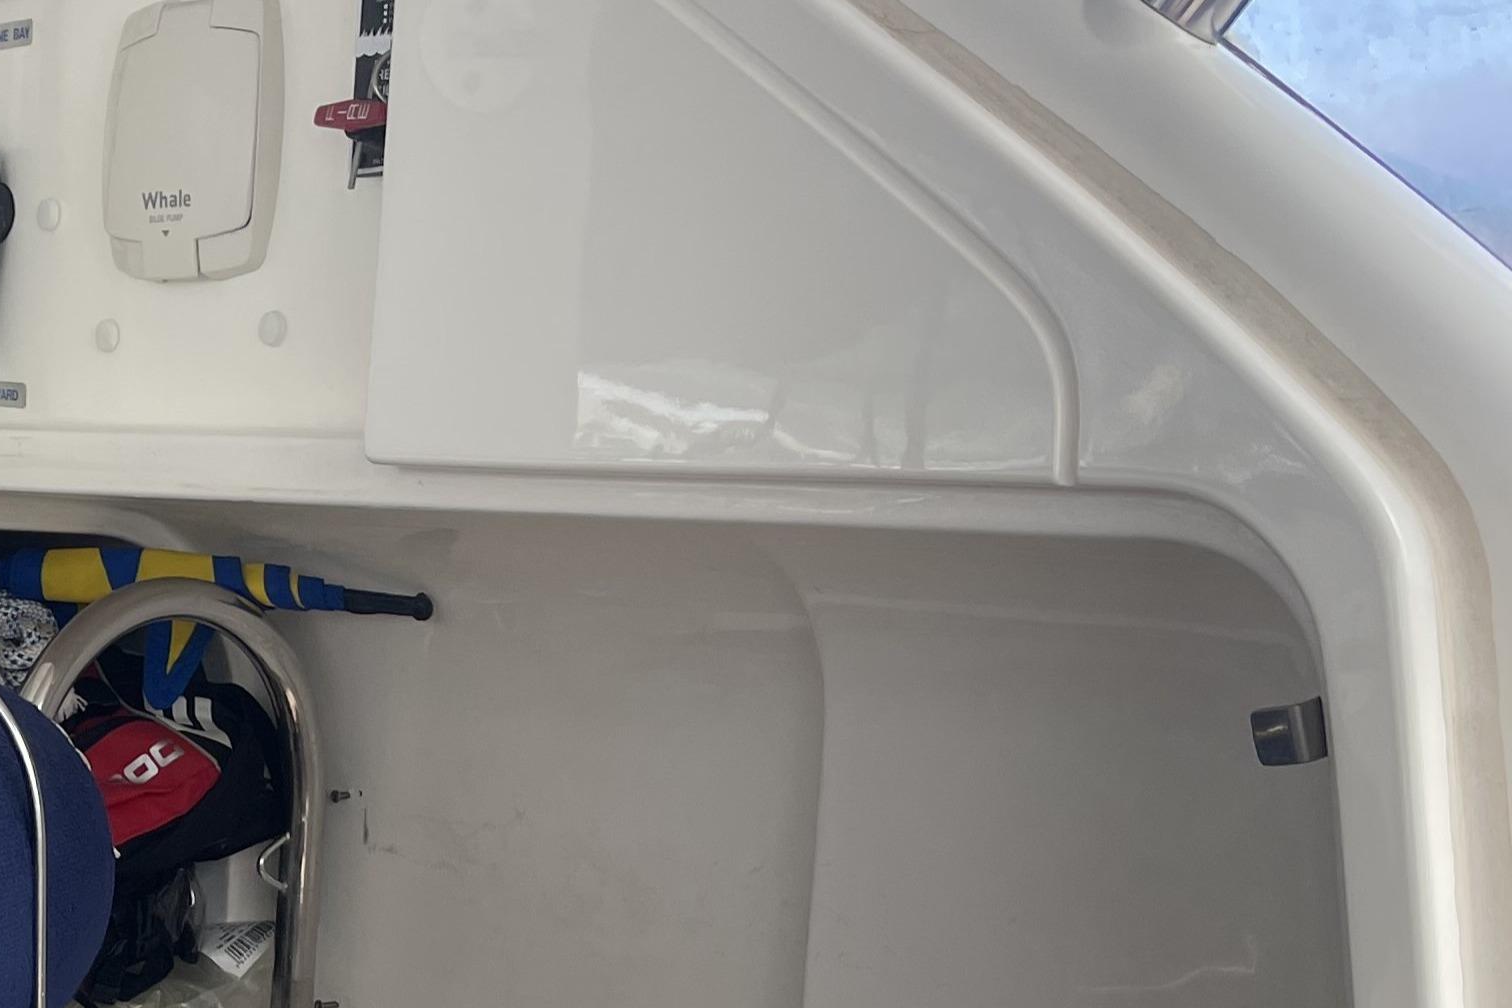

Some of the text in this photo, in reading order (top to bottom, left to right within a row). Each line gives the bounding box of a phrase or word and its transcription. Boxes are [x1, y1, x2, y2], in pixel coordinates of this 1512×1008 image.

[13, 27, 30, 40] BAY
[324, 103, 371, 121] FIRE
[142, 189, 191, 210] Whale
